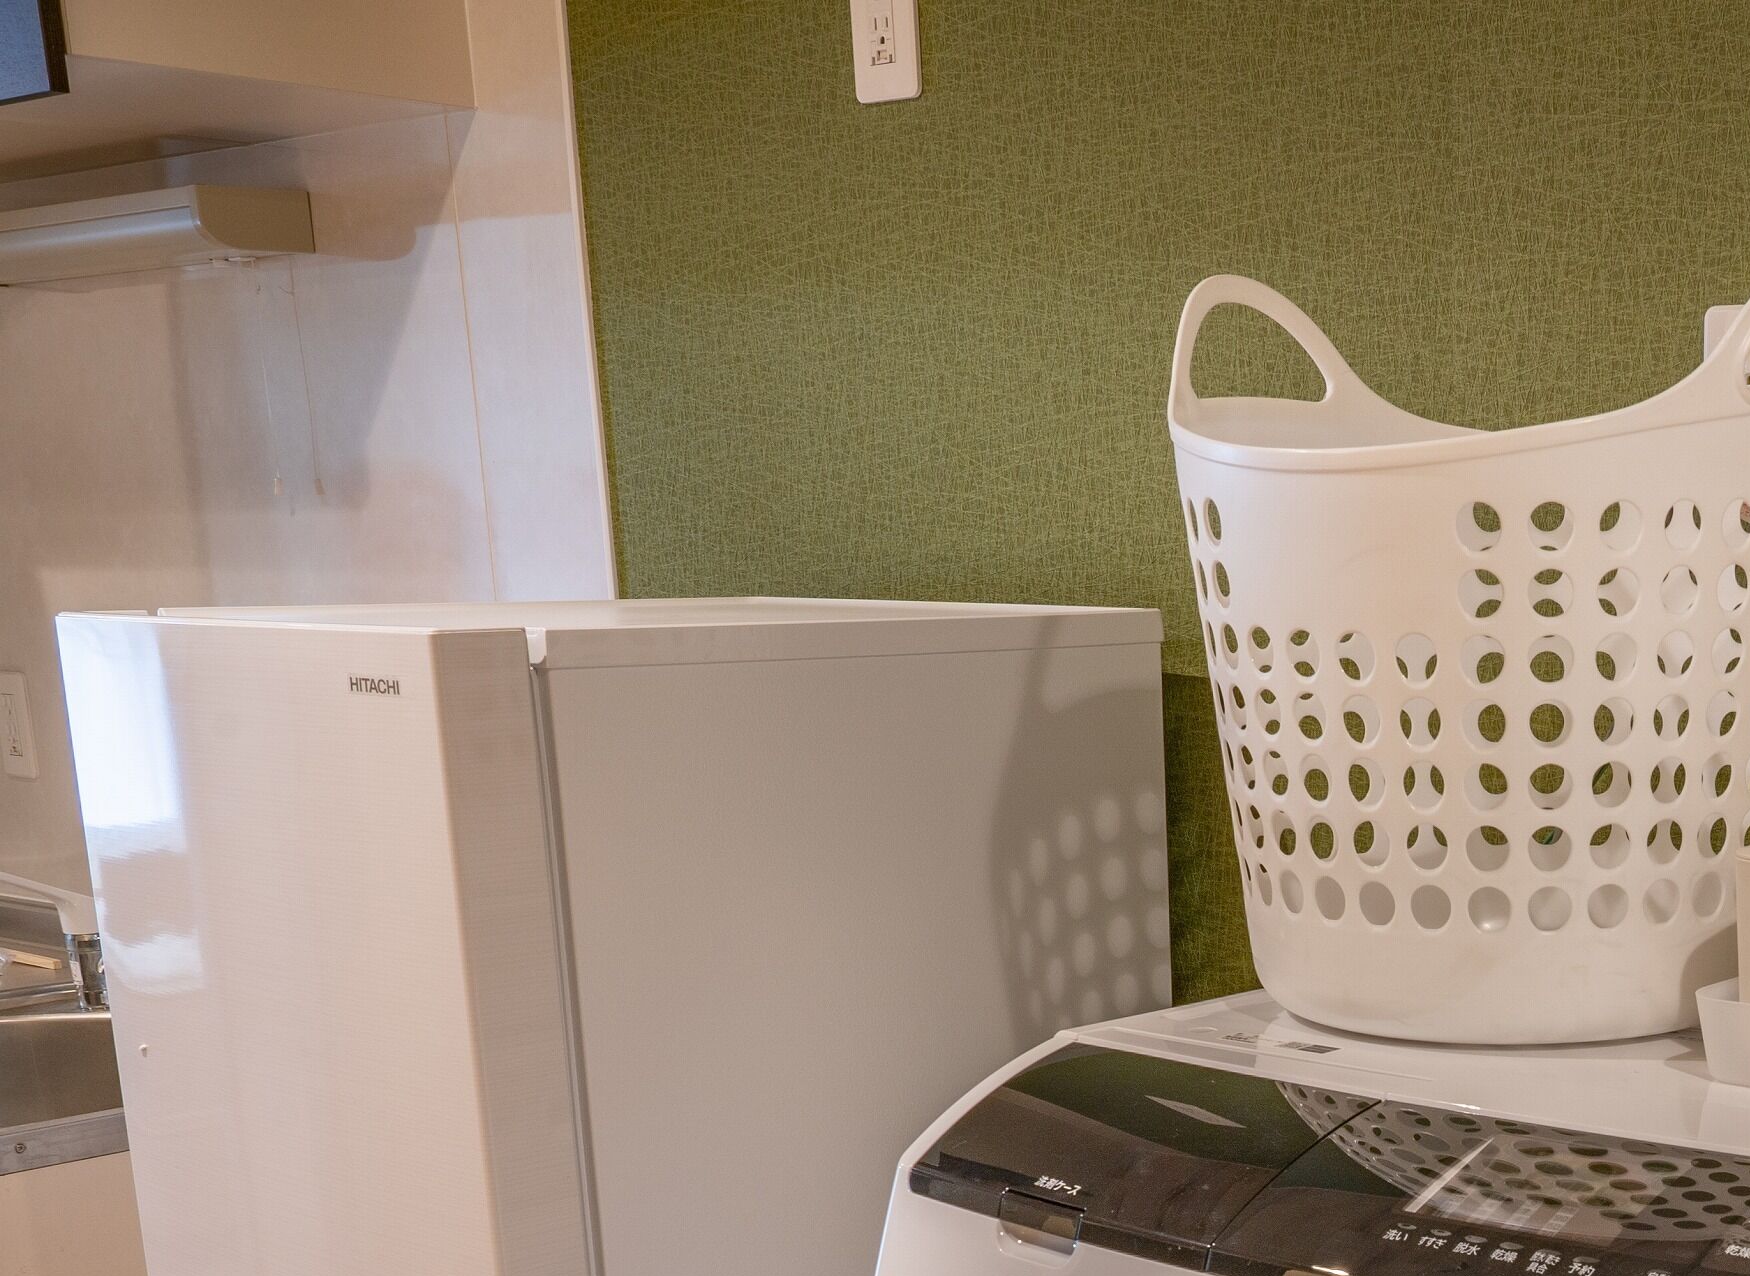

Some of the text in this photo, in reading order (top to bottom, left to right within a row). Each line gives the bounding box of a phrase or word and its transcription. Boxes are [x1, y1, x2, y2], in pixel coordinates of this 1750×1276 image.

[349, 676, 400, 695] HITACHI
[1034, 1175, 1082, 1196] 洗剤ケース
[1382, 1229, 1409, 1242] 洗い
[1417, 1236, 1448, 1250] すすぎ
[1452, 1241, 1481, 1256] 脱水
[1490, 1248, 1519, 1263] 乾燥
